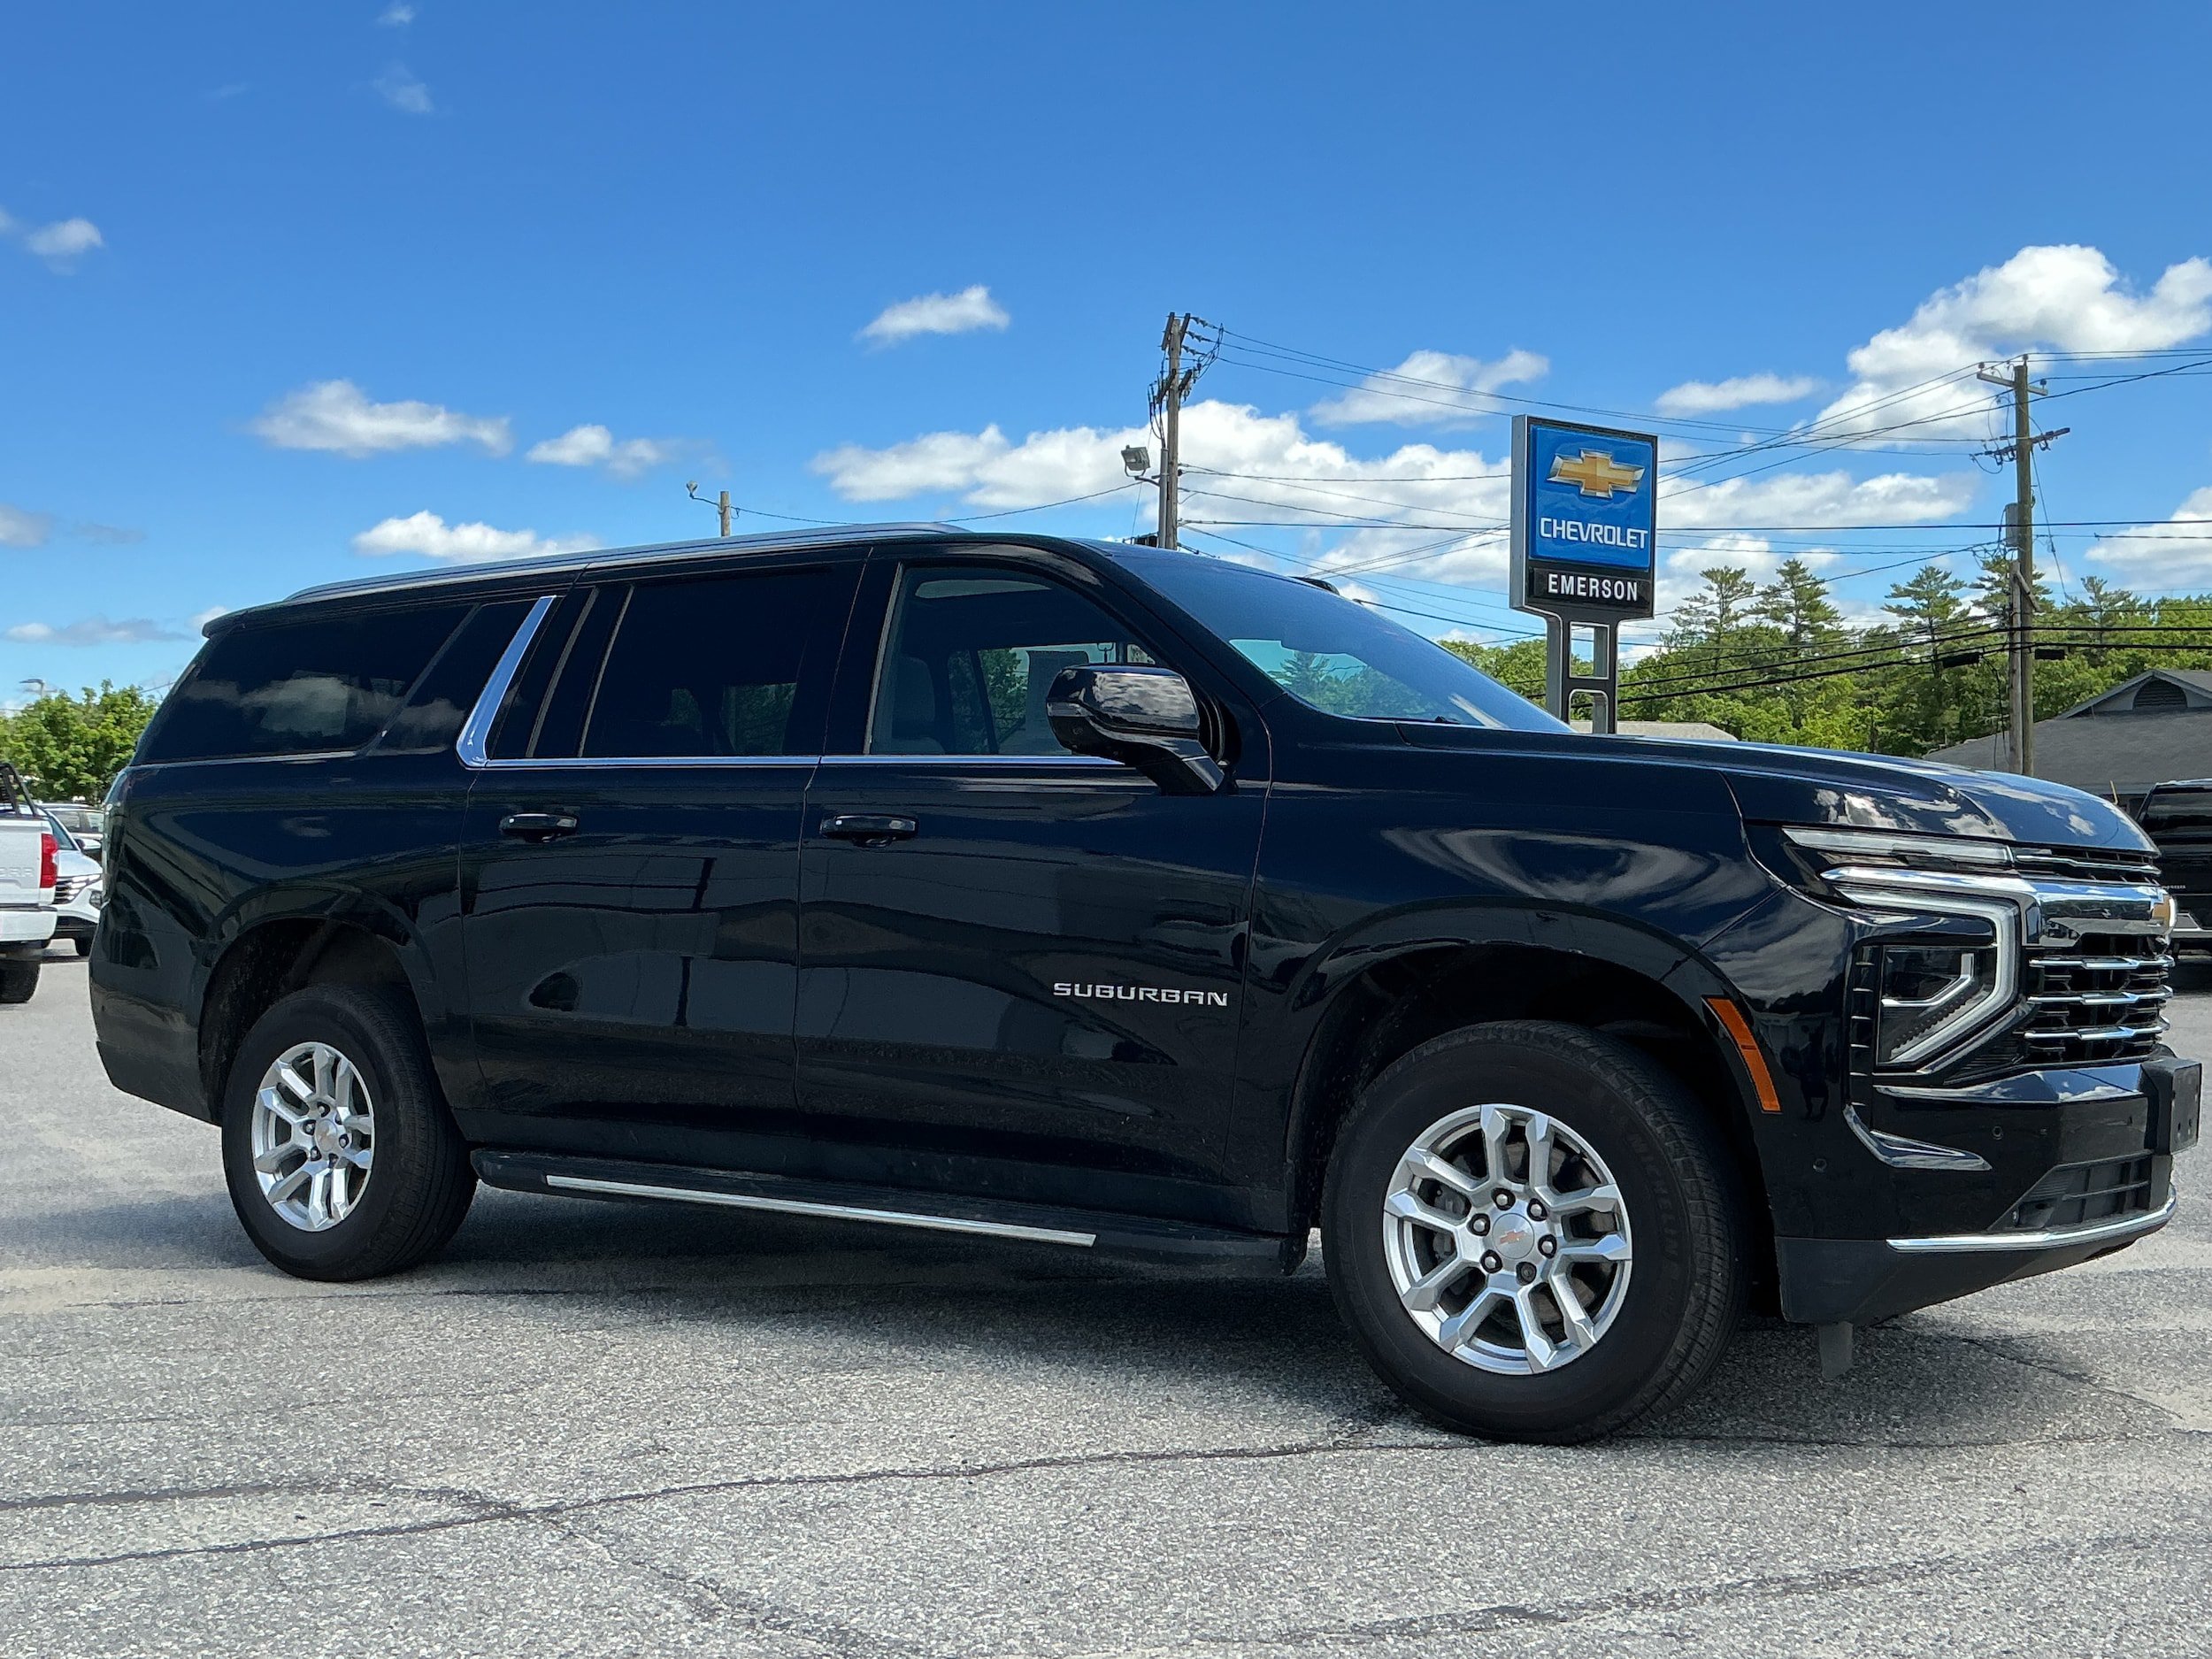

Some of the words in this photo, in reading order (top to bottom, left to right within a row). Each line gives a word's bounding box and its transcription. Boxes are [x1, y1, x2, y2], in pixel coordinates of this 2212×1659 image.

[1540, 517, 1648, 549] CHEVROLET
[1548, 573, 1637, 602] EMERSON
[1053, 982, 1228, 1007] SUBURBAN
[1626, 1133, 1678, 1256] MICHELIN
